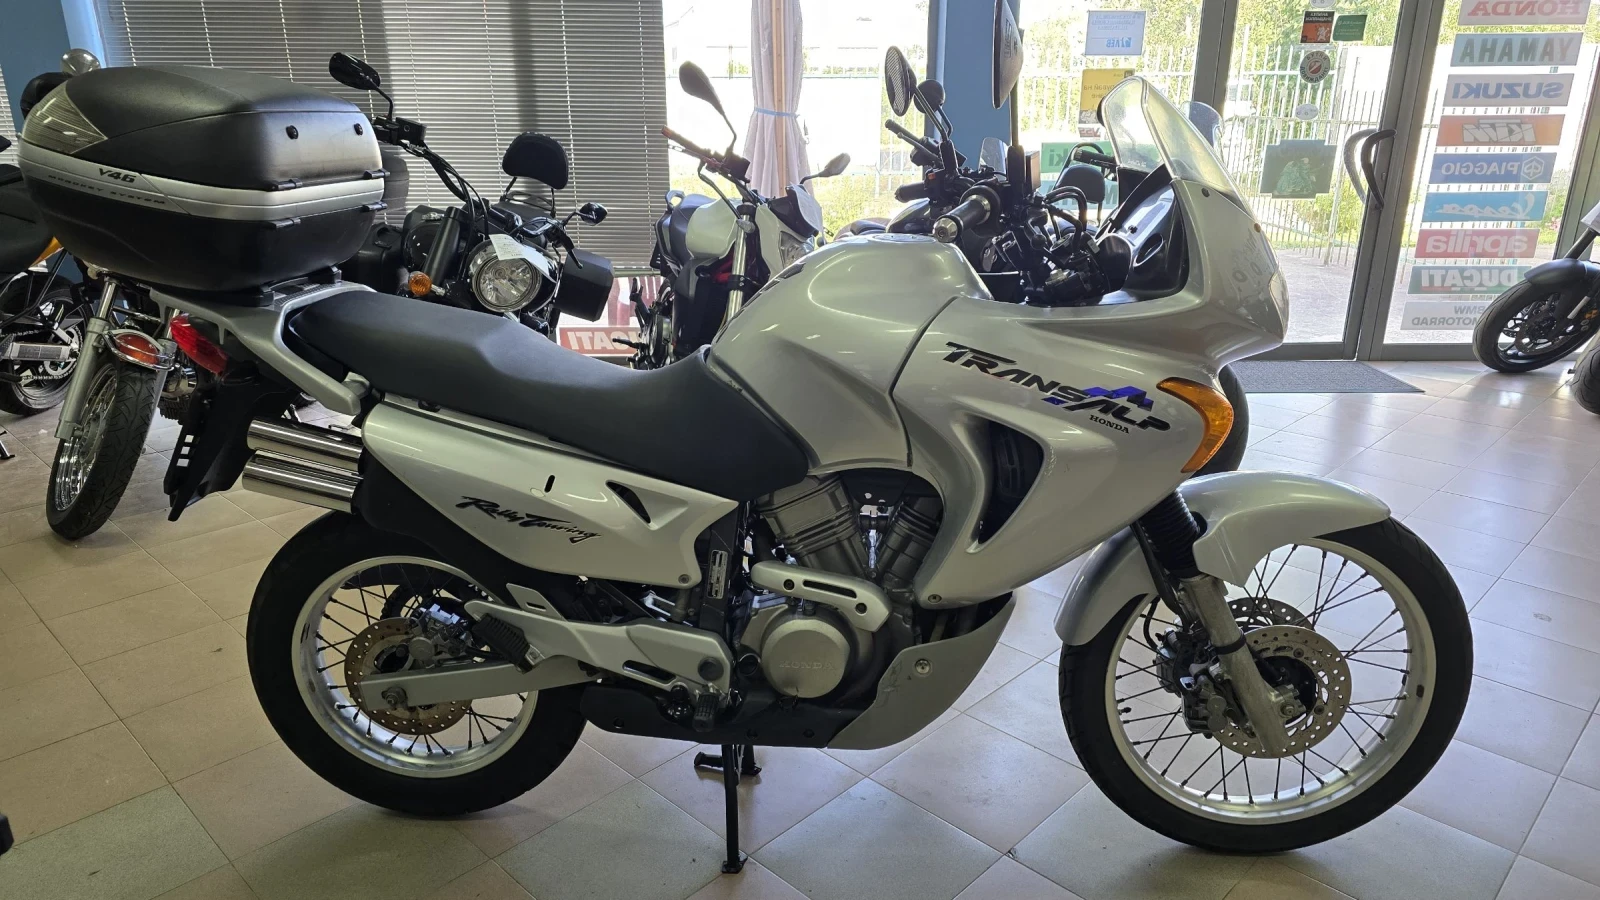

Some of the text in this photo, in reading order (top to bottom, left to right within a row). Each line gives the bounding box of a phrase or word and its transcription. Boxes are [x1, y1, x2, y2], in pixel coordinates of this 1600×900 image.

[99, 167, 137, 183] V46
[110, 190, 165, 204] SYSTEM
[1089, 414, 1130, 435] HONDA
[455, 496, 602, 545] Rally Touring
[779, 660, 835, 670] HONDA
